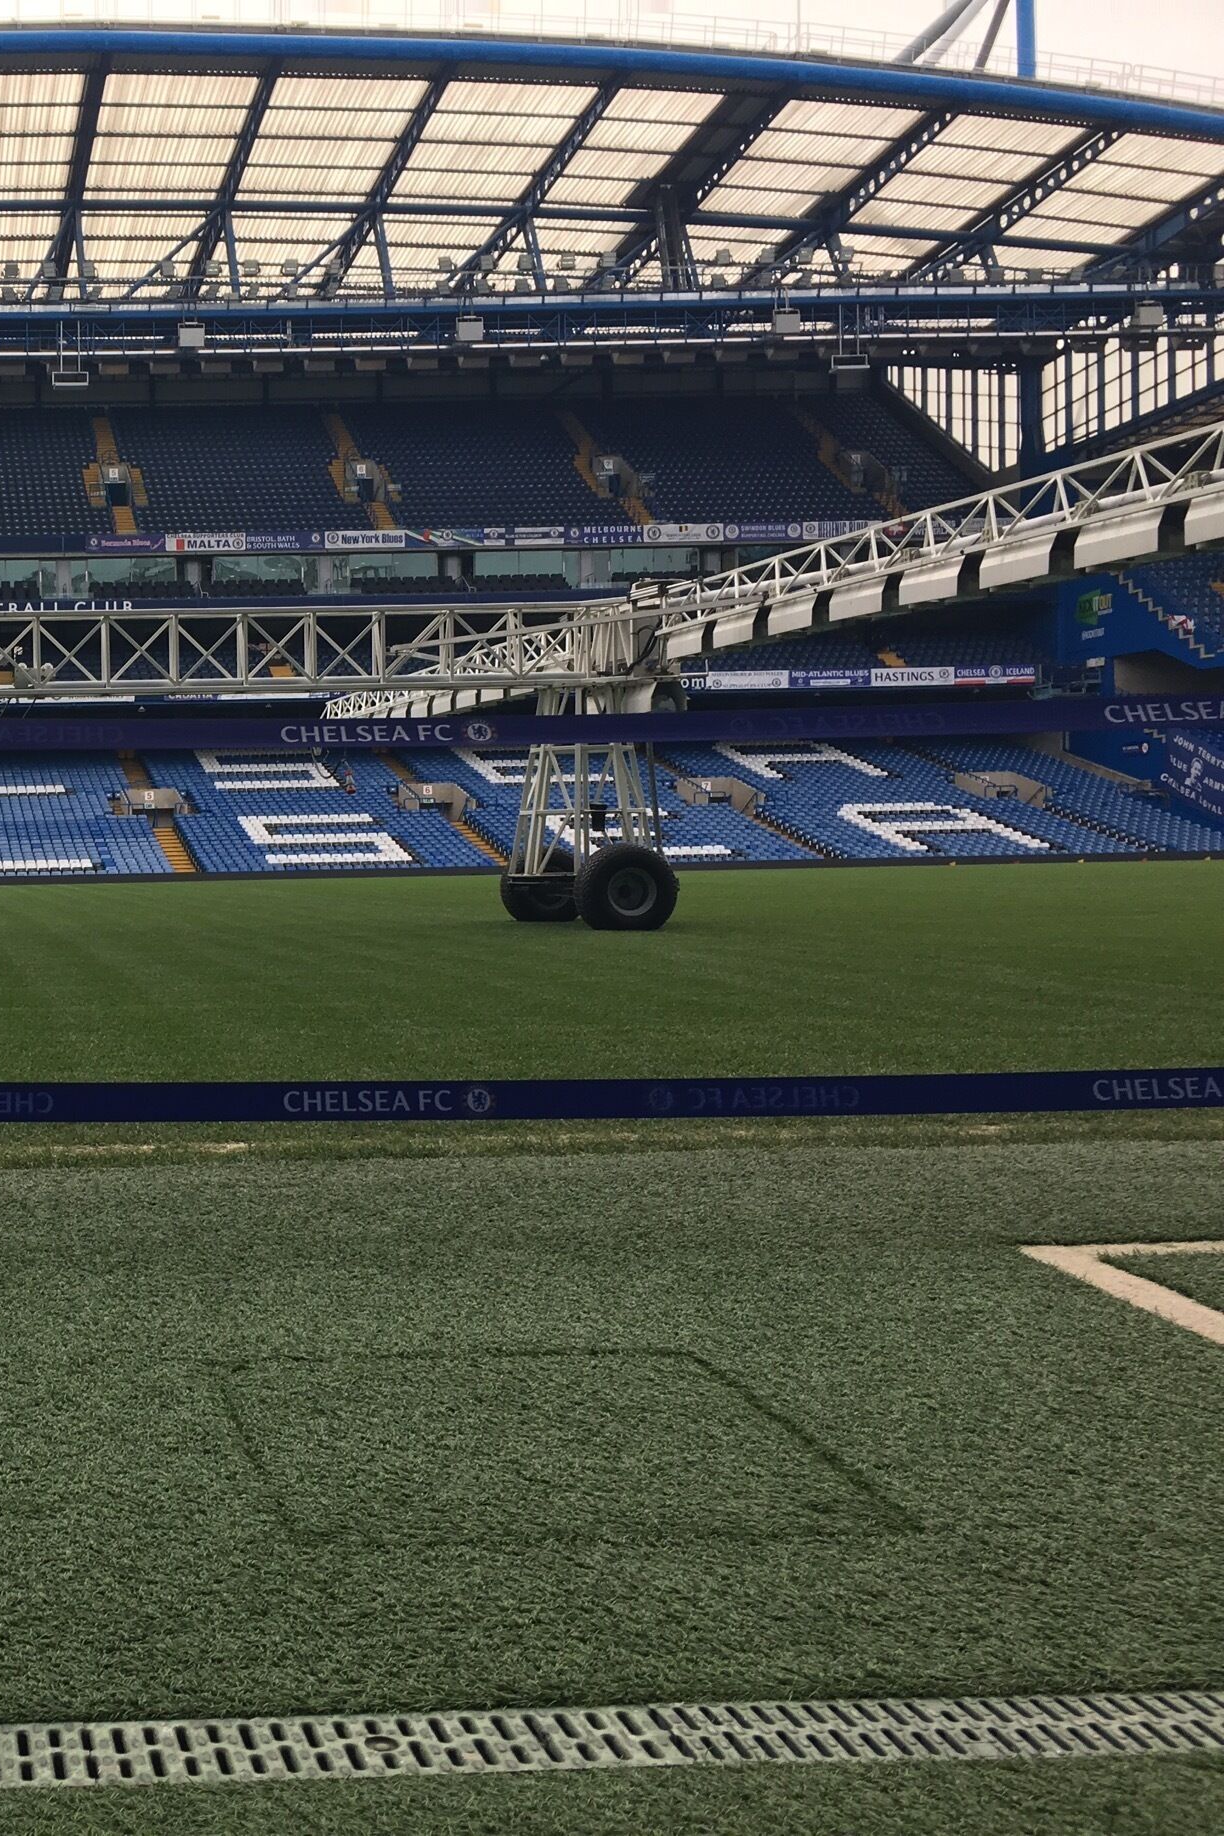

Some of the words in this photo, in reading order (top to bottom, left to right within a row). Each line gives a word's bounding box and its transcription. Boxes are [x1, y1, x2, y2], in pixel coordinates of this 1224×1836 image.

[584, 525, 642, 534] MELBOURNE
[187, 539, 230, 549] MALTA
[341, 534, 359, 544] New
[360, 534, 380, 544] York
[382, 533, 404, 544] Blues
[874, 671, 934, 682] HASTINGS
[956, 669, 986, 677] CHELSEA
[1006, 667, 1034, 676] ICELAND
[1104, 701, 1224, 723] CHELSE
[280, 723, 408, 744] CHELSEA
[418, 722, 452, 743] FC
[1174, 736, 1194, 752] JOHN
[1160, 773, 1196, 800] CHELSEA
[1198, 796, 1222, 815] LOYAL
[1092, 1077, 1223, 1100] CHELSEA
[284, 1090, 410, 1115] CHELSEA
[417, 1090, 453, 1113] FC
